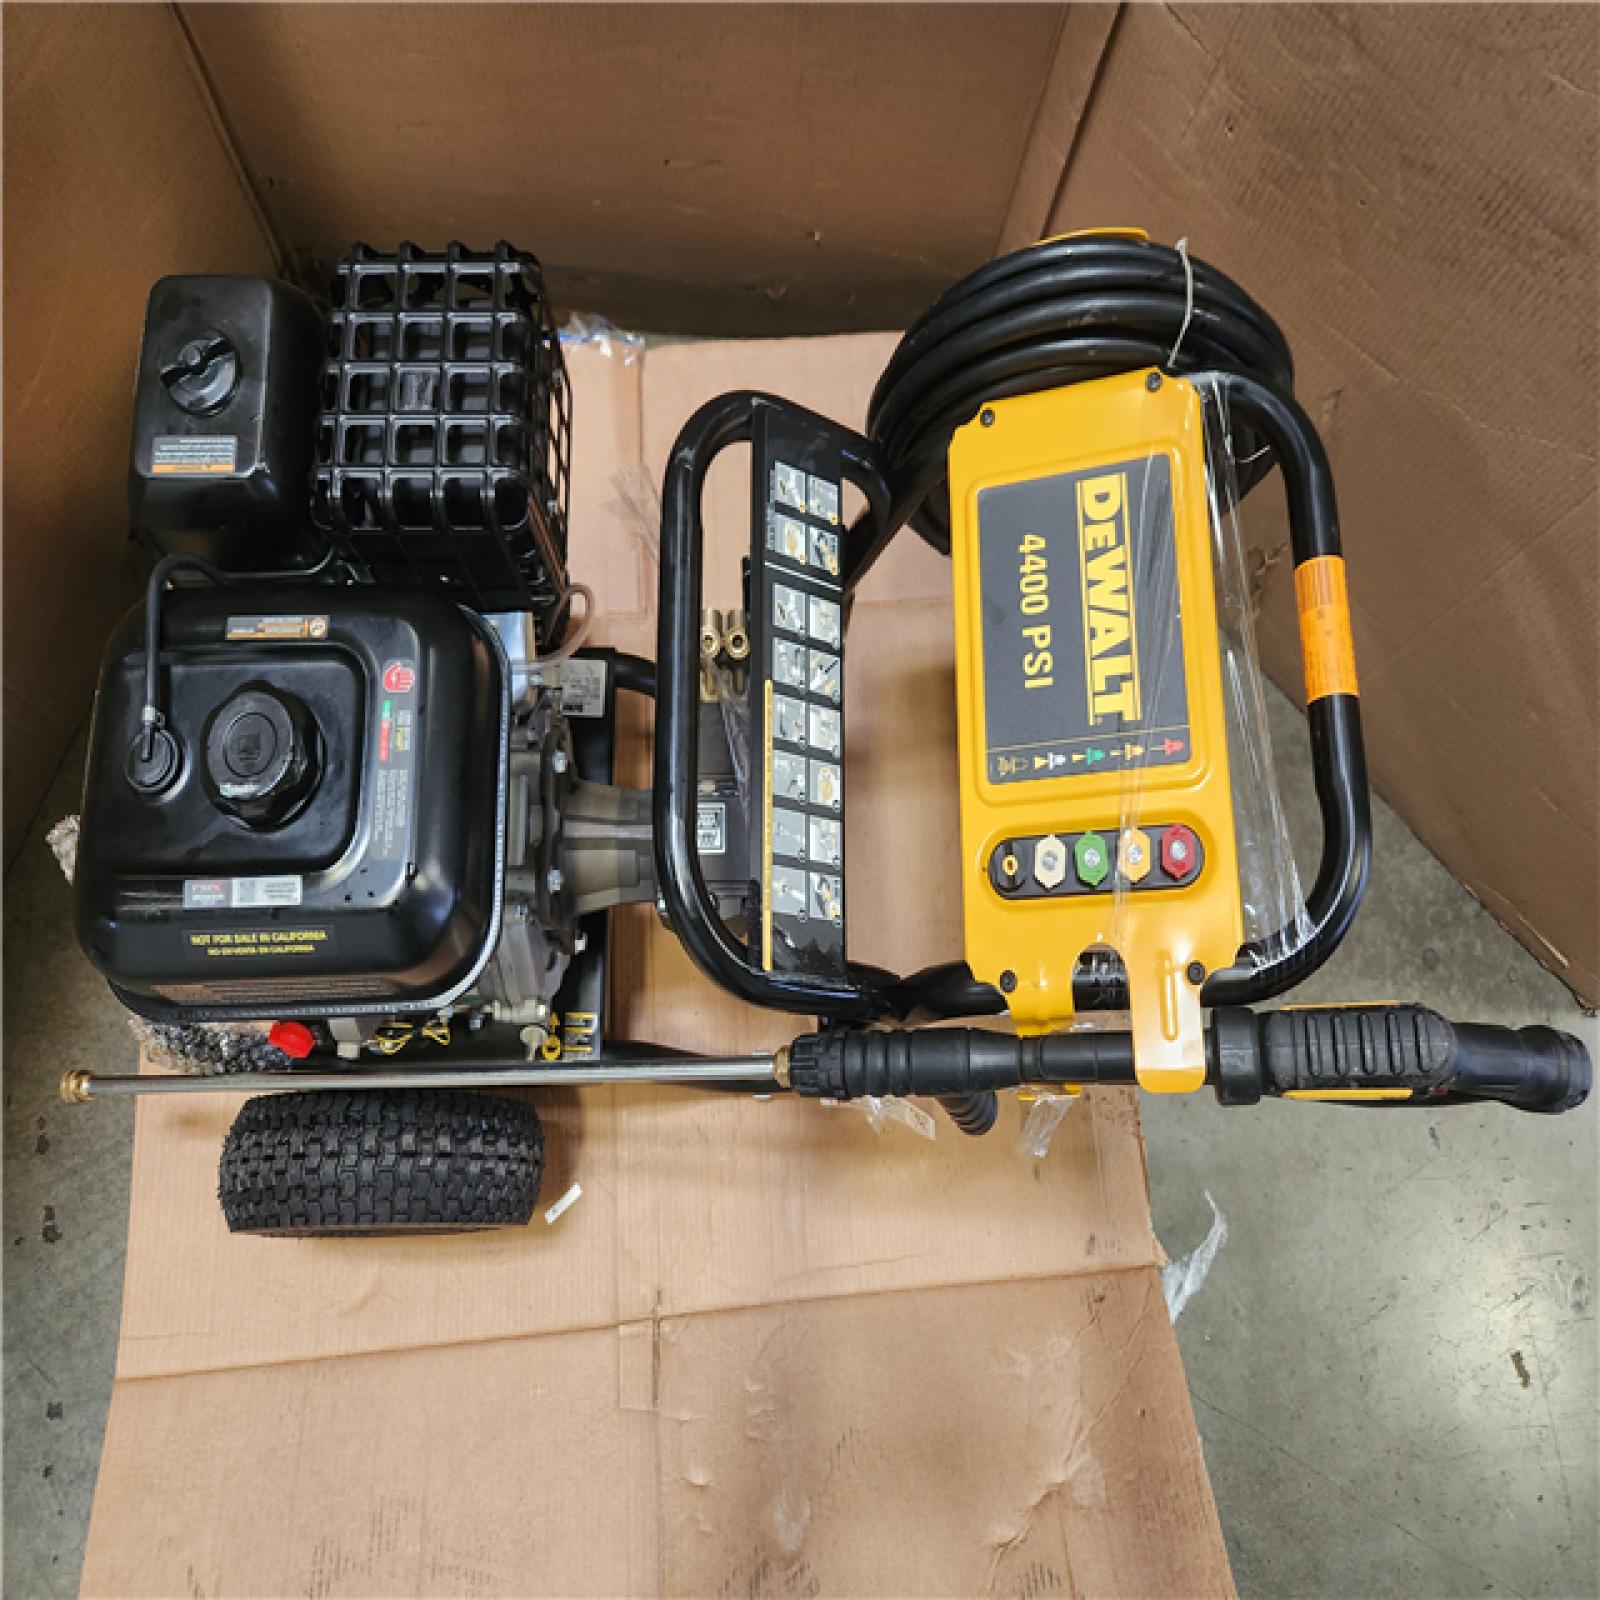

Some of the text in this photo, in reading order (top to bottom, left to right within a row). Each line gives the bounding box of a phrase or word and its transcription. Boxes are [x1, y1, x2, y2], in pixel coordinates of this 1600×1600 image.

[1018, 532, 1054, 689] 4400 PSI
[1082, 473, 1137, 721] DEWALT
[191, 930, 327, 945] NOT FOR SALE IN CALIFORNIA
